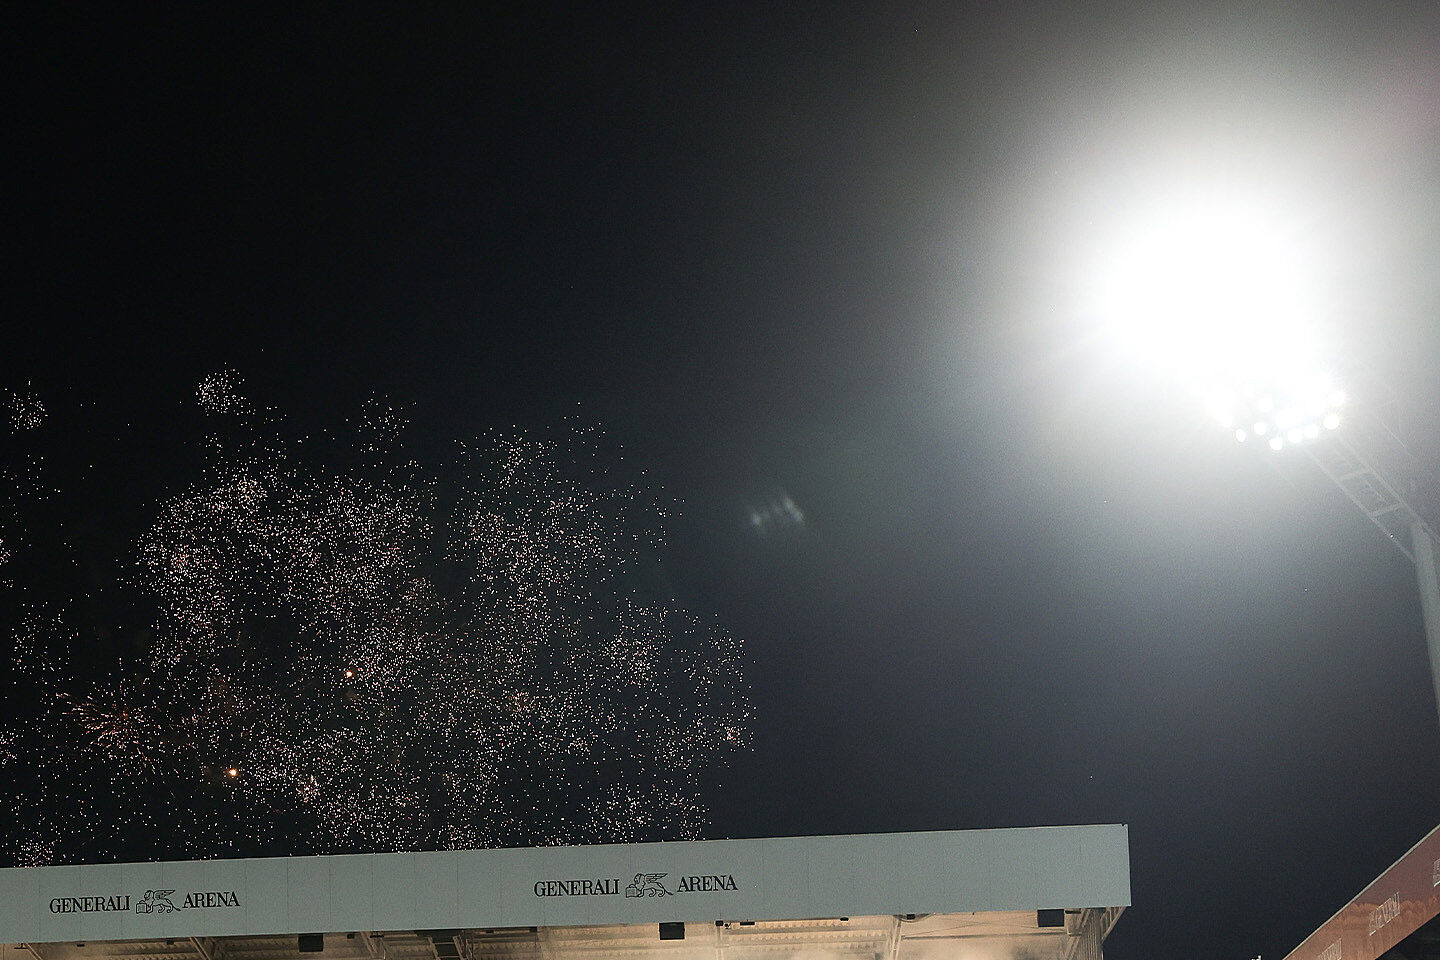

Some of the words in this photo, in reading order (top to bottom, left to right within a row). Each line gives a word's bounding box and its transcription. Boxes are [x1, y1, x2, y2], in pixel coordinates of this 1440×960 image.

[534, 878, 620, 898] GENERALI
[676, 874, 739, 893] ARENA
[49, 895, 131, 914] GENERALI
[182, 890, 241, 909] ARENA
